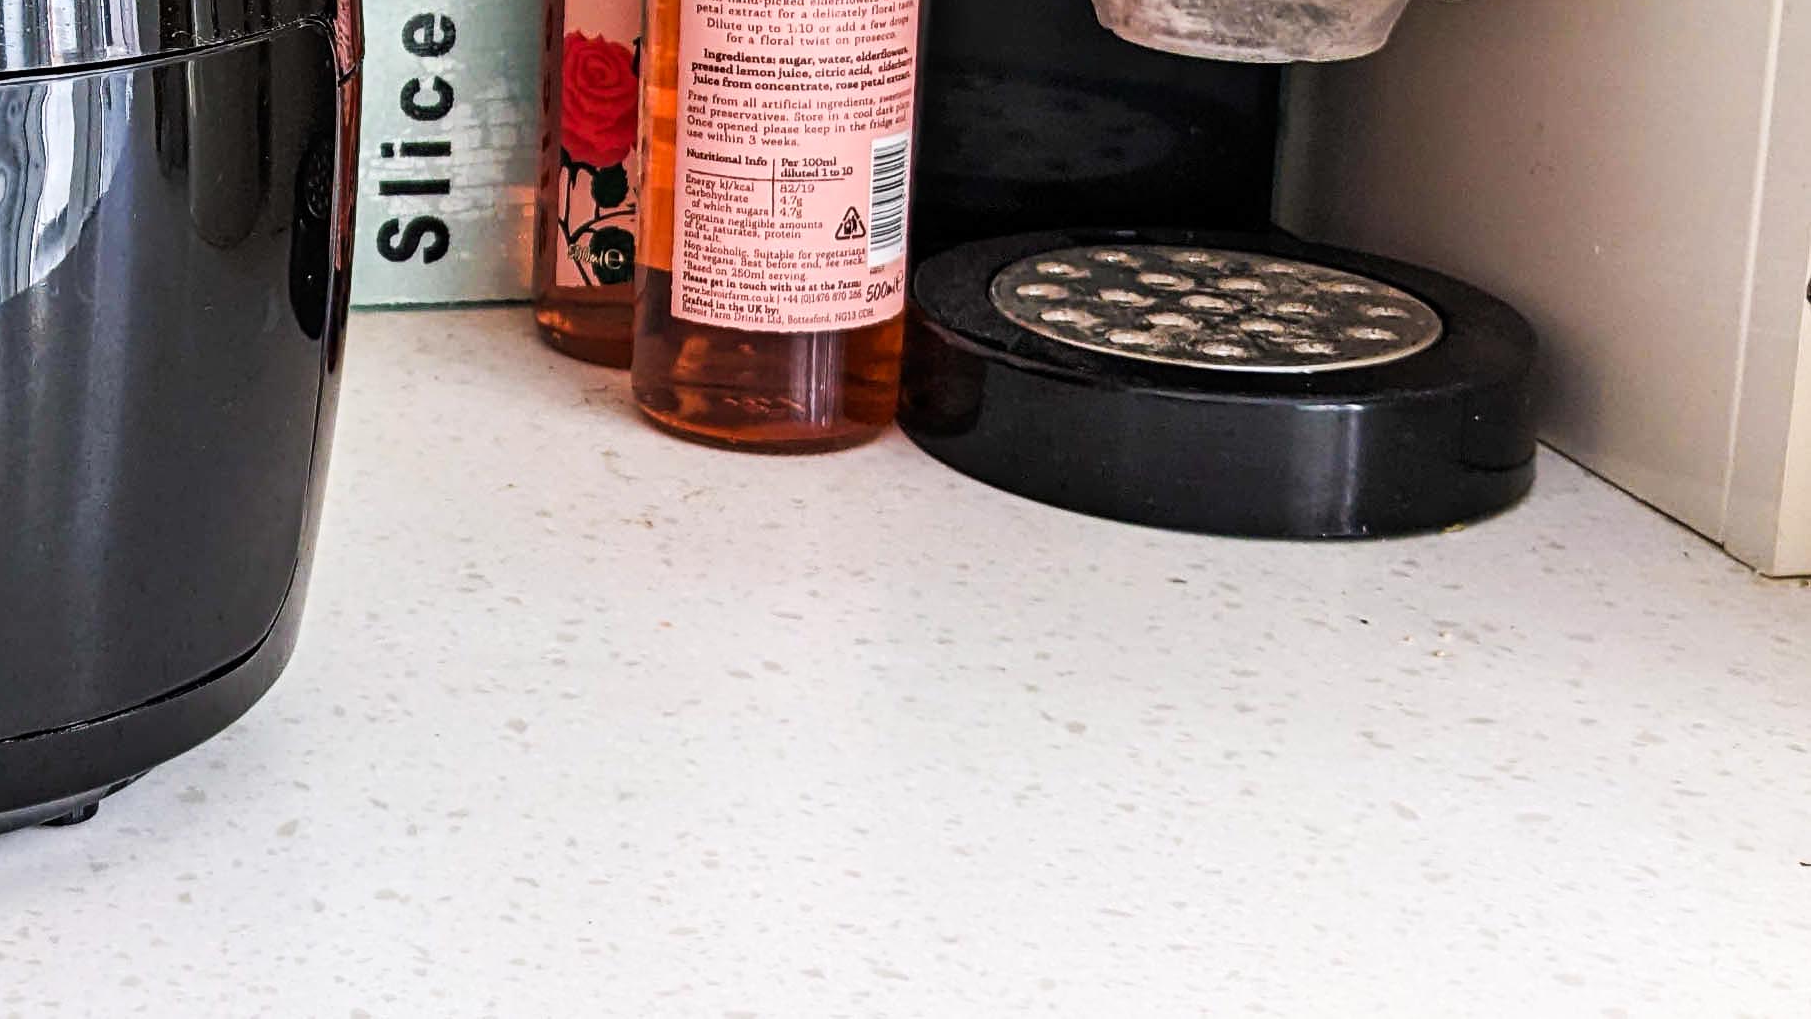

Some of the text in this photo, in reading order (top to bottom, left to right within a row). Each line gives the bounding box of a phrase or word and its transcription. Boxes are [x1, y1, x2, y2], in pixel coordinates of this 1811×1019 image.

[697, 4, 723, 14] petal
[729, 7, 772, 18] extract
[778, 9, 795, 19] for
[801, 11, 807, 19] a
[813, 6, 867, 19] delicately
[872, 3, 895, 15] floral
[707, 17, 887, 34] Dilute up to or add few
[727, 32, 744, 43] for
[760, 34, 794, 45] floral
[800, 37, 830, 46] twist
[835, 37, 849, 45] on
[704, 48, 854, 67] Ingredients: sugar, water,
[692, 62, 733, 74] pressed
[737, 65, 775, 77] lemon
[778, 68, 812, 79] juice,
[815, 67, 845, 77] citric
[693, 72, 885, 91] juice from concentrate, rose petal
[687, 89, 708, 102] Free
[712, 94, 738, 107] from
[743, 97, 757, 108] all
[762, 99, 811, 109] artificial
[687, 103, 706, 114] and
[794, 112, 823, 122] Store
[829, 112, 838, 120] in
[853, 107, 872, 119] cool
[687, 114, 713, 128] Once
[717, 122, 758, 135] opened
[764, 124, 799, 135] please
[804, 122, 830, 135] keep
[835, 124, 845, 133] in
[850, 122, 866, 132] the
[376, 10, 456, 265] Slice
[687, 129, 756, 145] use within 3
[686, 147, 837, 167] Nutritional Info Per 100ml
[685, 173, 716, 189] Energy
[780, 166, 853, 178] diluted to 10
[685, 185, 749, 203] Carbohydrate
[691, 199, 769, 217] of which sugars
[684, 209, 823, 230] Contains negligible amounts
[684, 229, 700, 239] and
[764, 230, 801, 240] protein
[684, 250, 839, 269] and Best before see
[754, 247, 866, 260] Suitable for vegetarians
[716, 268, 727, 276] on
[683, 271, 835, 292] Please get touch with us at the
[682, 294, 762, 313] Crafted in the UK
